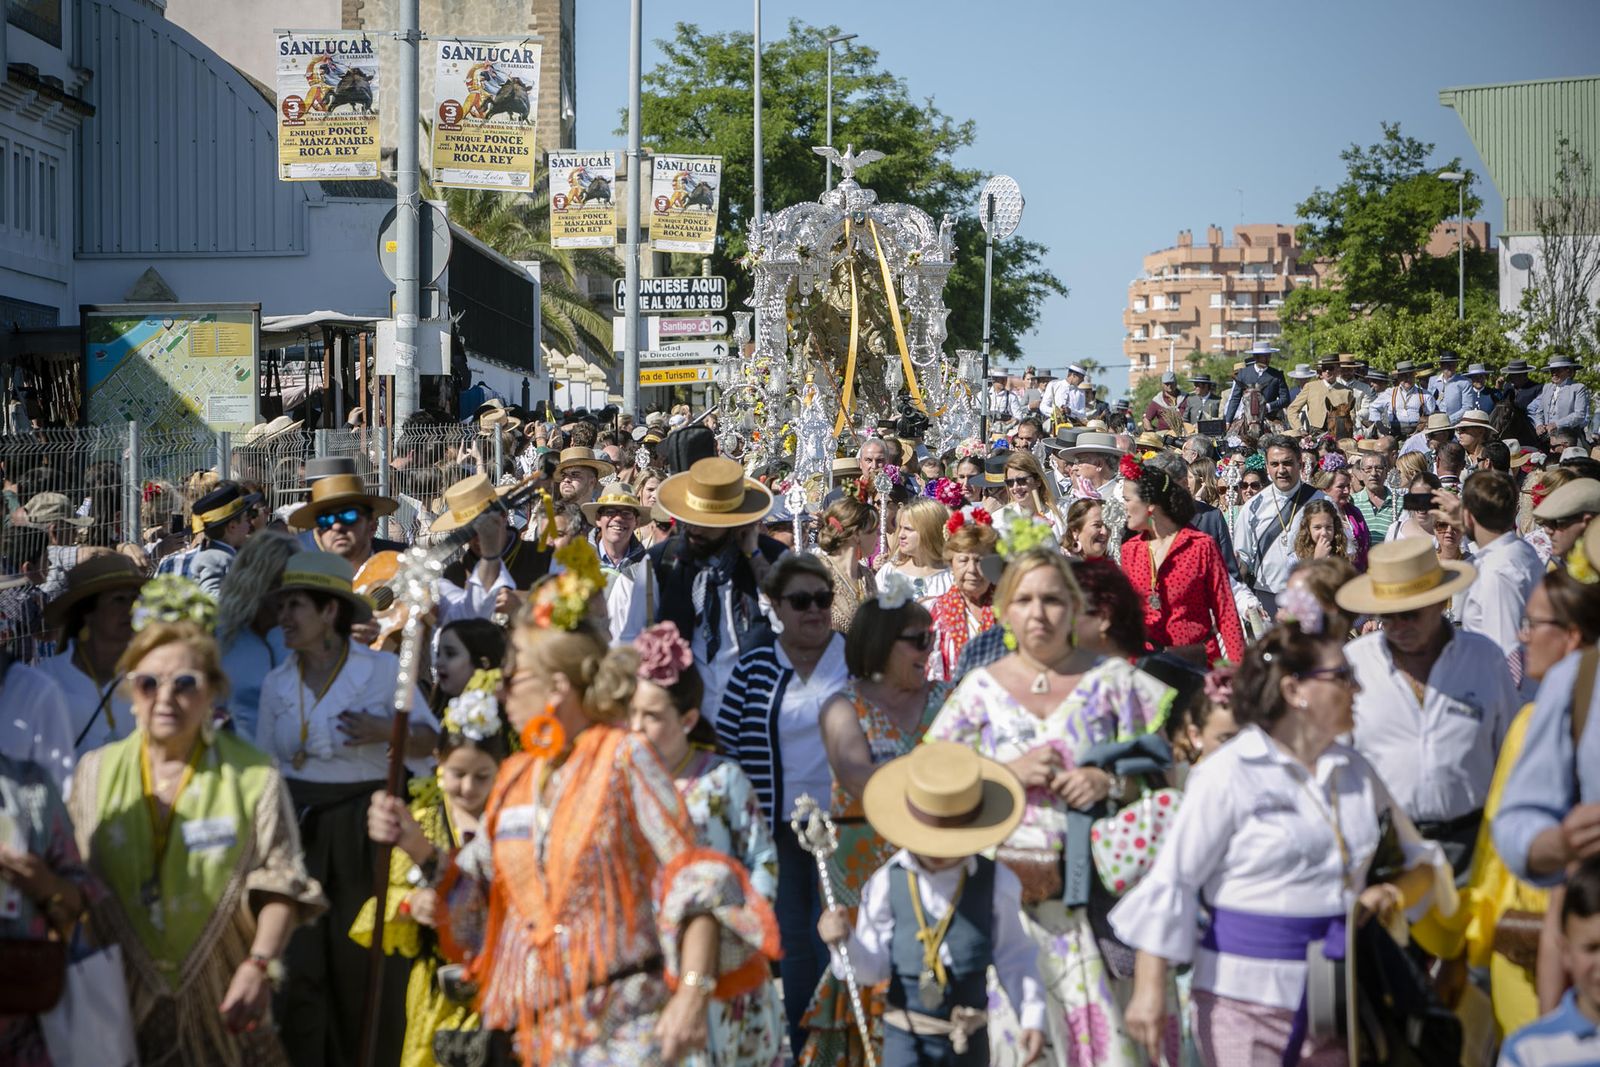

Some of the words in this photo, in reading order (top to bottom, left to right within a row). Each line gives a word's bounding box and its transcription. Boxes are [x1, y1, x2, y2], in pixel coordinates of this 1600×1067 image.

[288, 101, 300, 113] 3
[444, 106, 457, 117] 3
[328, 126, 368, 136] PONCE
[300, 136, 374, 146] MANZANARES
[445, 134, 482, 142] ENRIQUE
[484, 134, 524, 145] PONCE
[300, 148, 332, 156] ROCA
[335, 146, 360, 156] REY
[454, 143, 529, 156] MANZANARES
[454, 154, 486, 163] ROCA
[490, 156, 514, 164] REY
[664, 224, 712, 232] MANZANARES
[618, 278, 688, 294] ANCIESE
[691, 278, 722, 293] AQUI
[651, 296, 664, 310] AL
[665, 296, 682, 309] 902
[684, 295, 696, 308] 10
[698, 295, 710, 308] 36
[710, 295, 722, 308] 69
[662, 322, 696, 332] Santiago
[665, 371, 695, 380] Turismo
